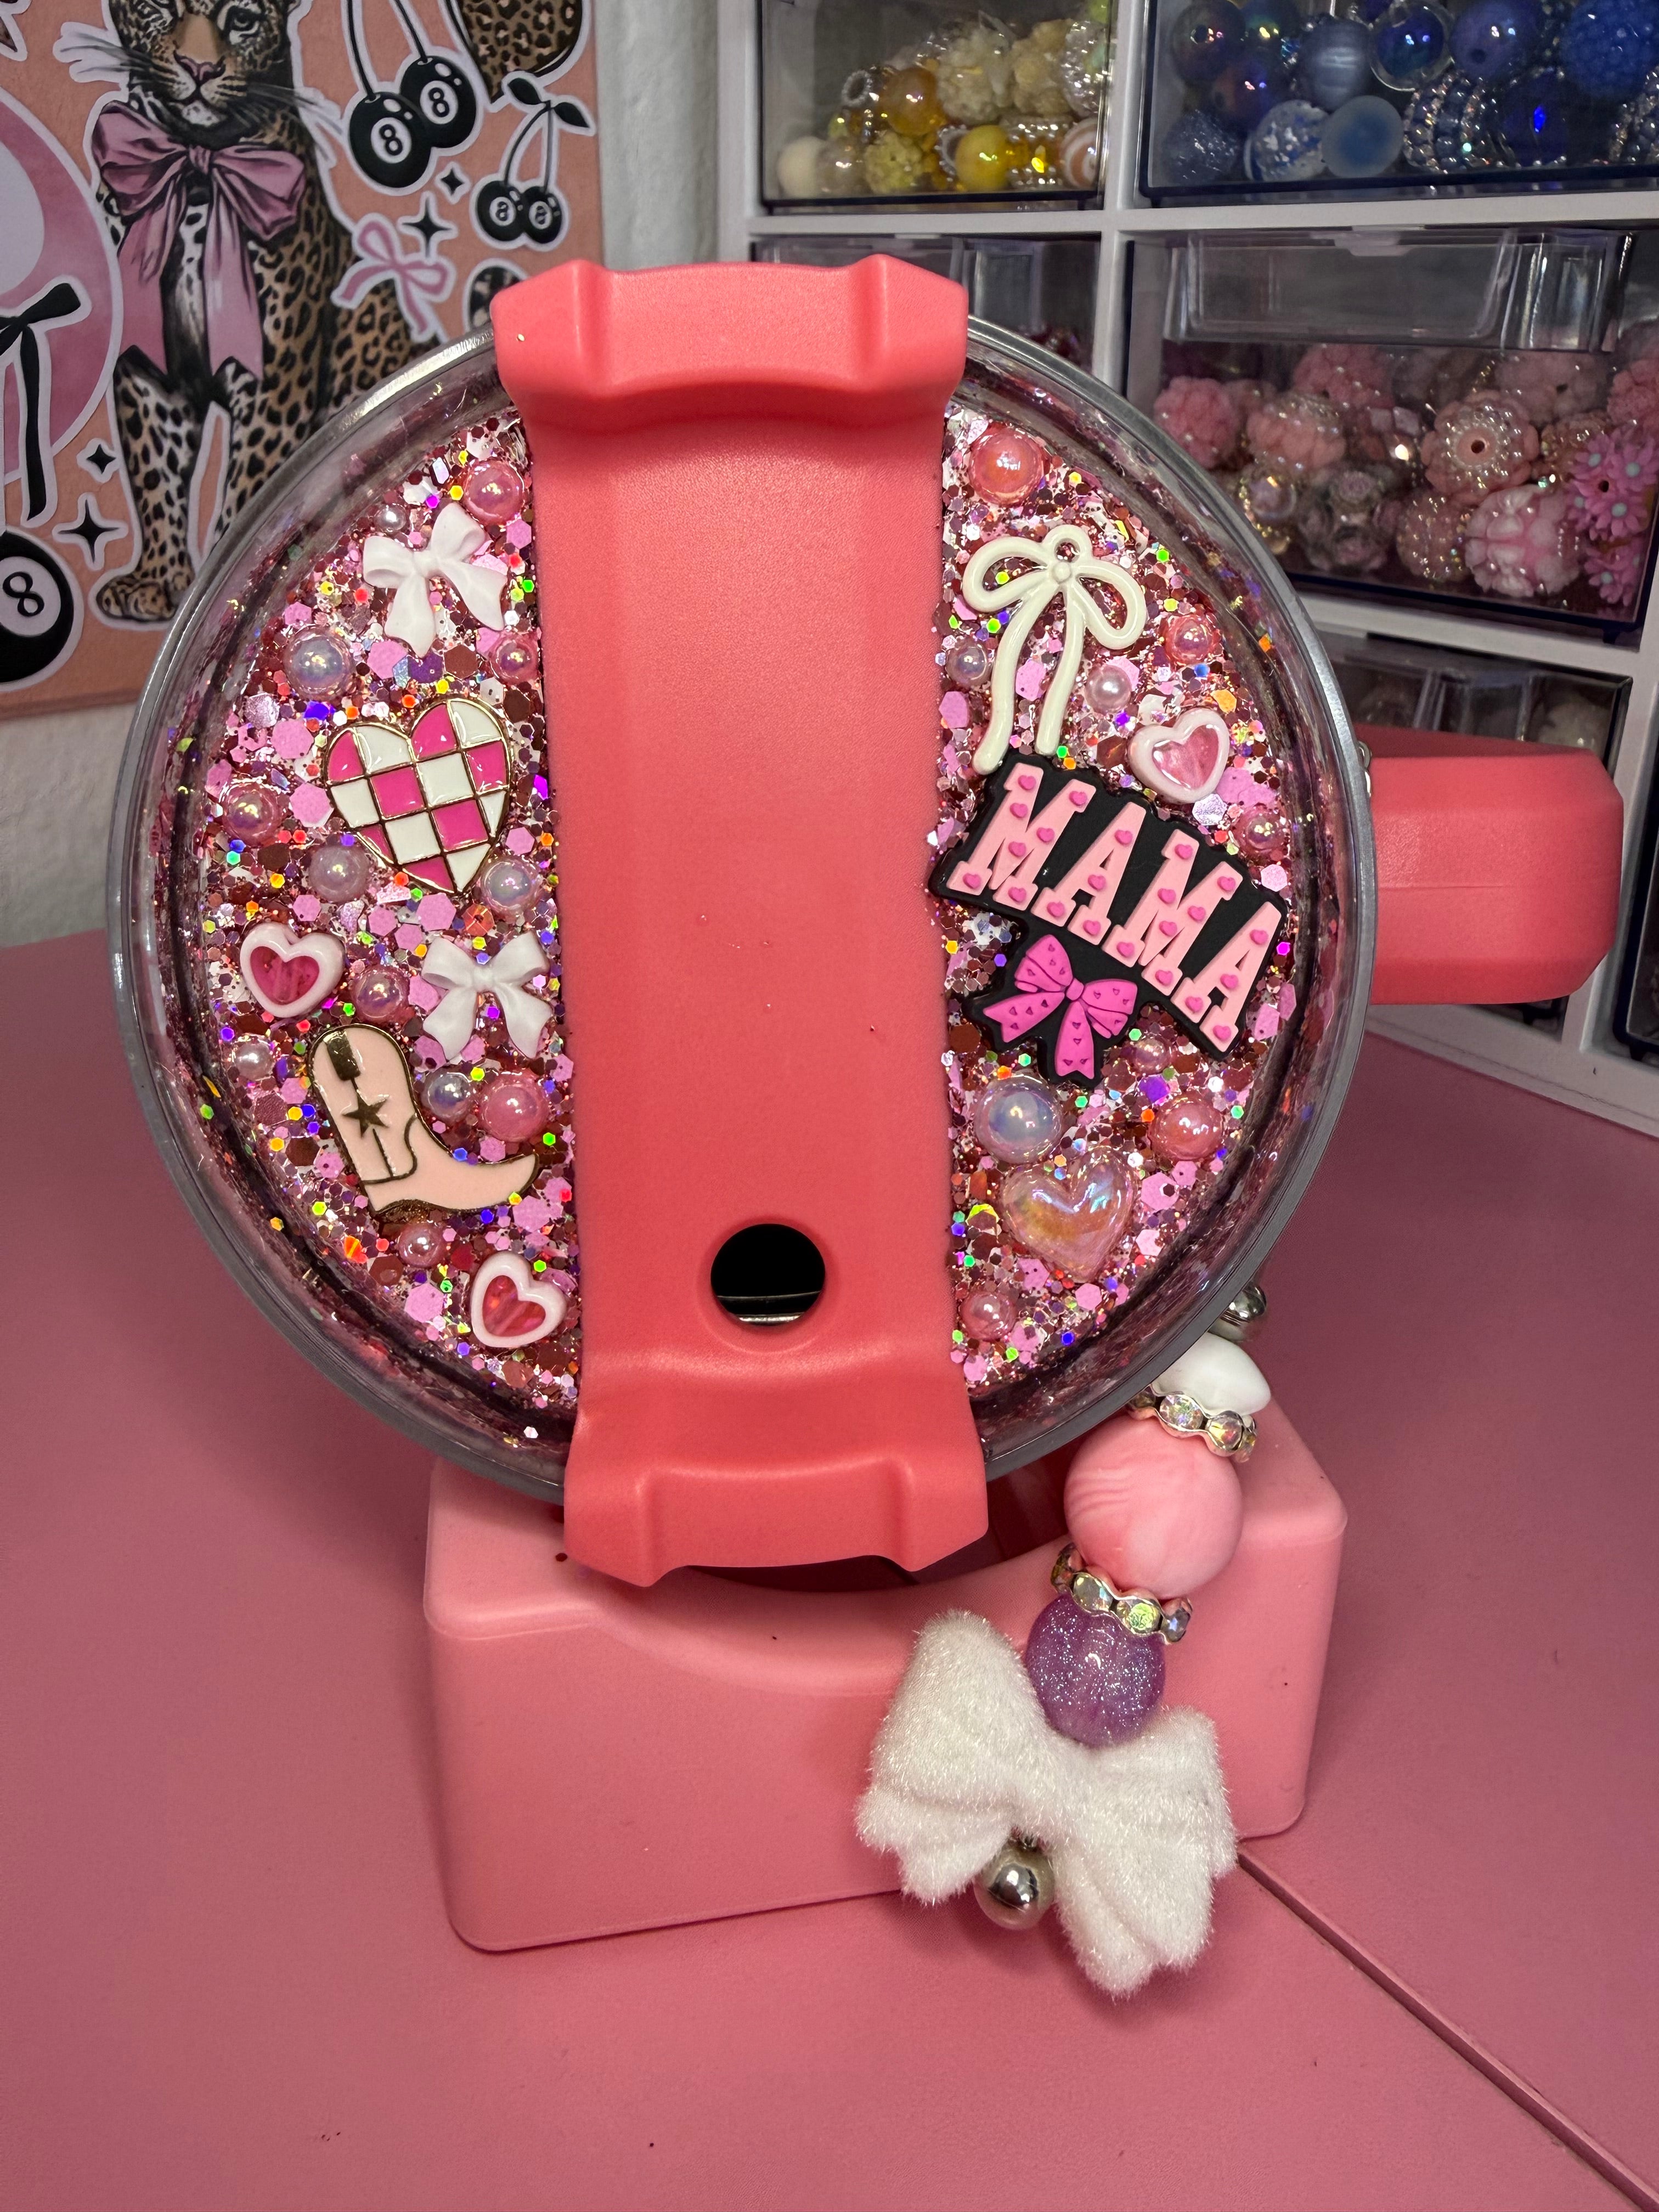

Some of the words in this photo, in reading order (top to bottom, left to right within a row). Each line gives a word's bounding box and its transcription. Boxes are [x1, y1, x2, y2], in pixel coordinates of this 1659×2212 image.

[428, 87, 450, 118] 8
[379, 124, 403, 156] 8
[495, 201, 509, 222] 8
[3, 572, 45, 617] 8
[946, 762, 1282, 1052] MAMA
